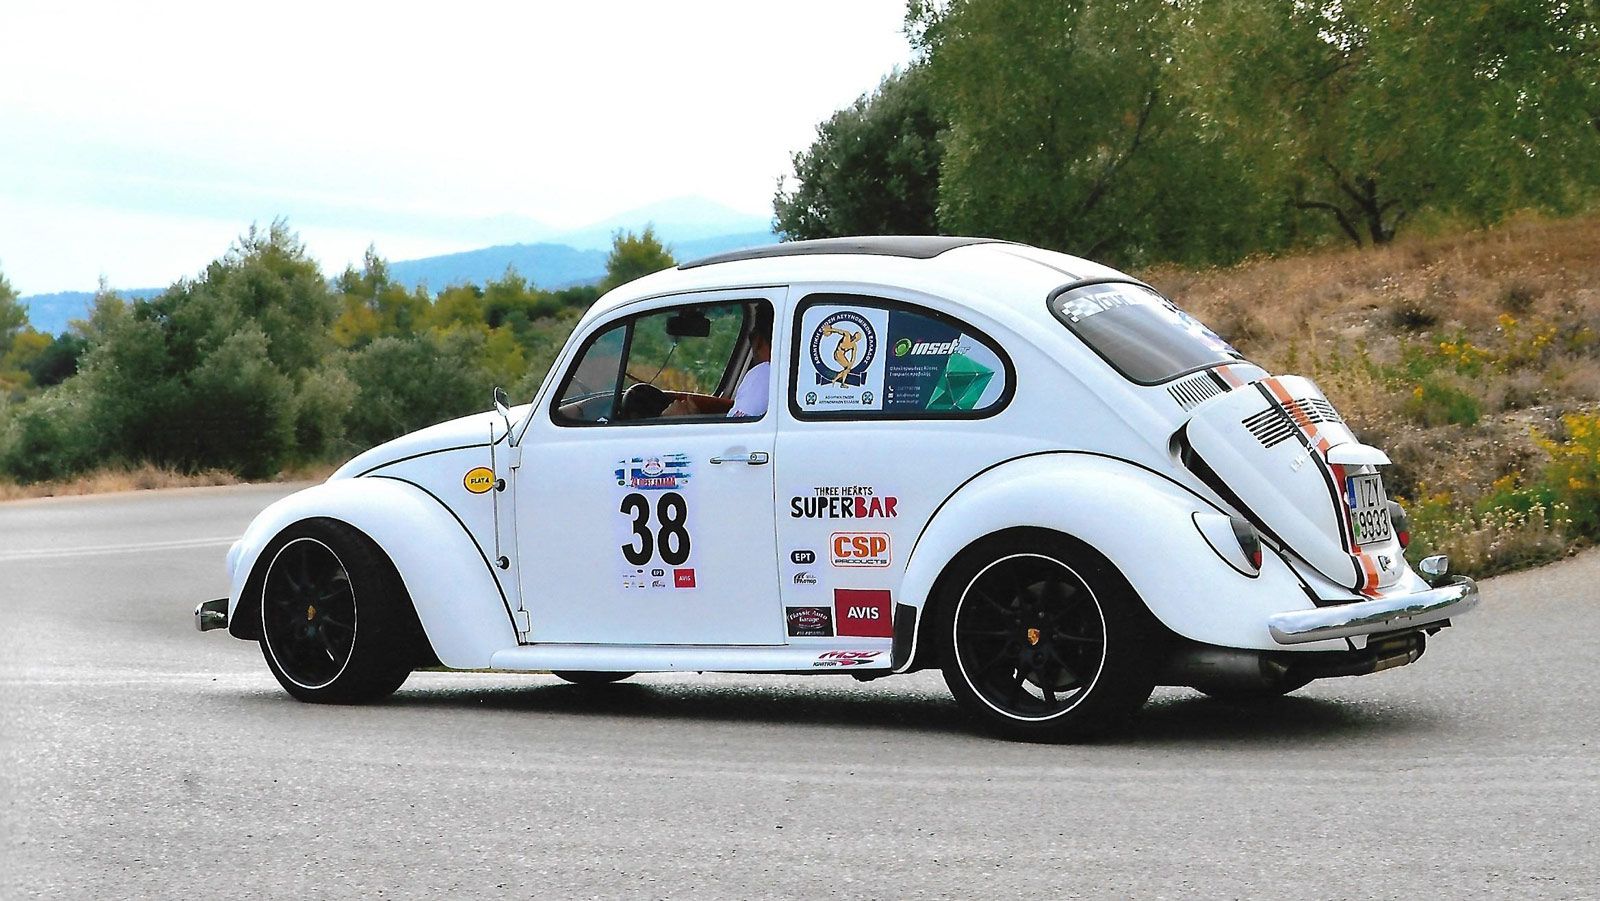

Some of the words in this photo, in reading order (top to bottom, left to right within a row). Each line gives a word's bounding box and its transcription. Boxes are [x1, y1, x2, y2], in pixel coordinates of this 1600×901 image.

[814, 486, 839, 496] THREE
[790, 496, 898, 518] SUPERBAR
[620, 492, 691, 566] 38
[1360, 508, 1389, 539] 9933
[834, 536, 887, 558] CSP
[847, 606, 879, 620] AVIS
